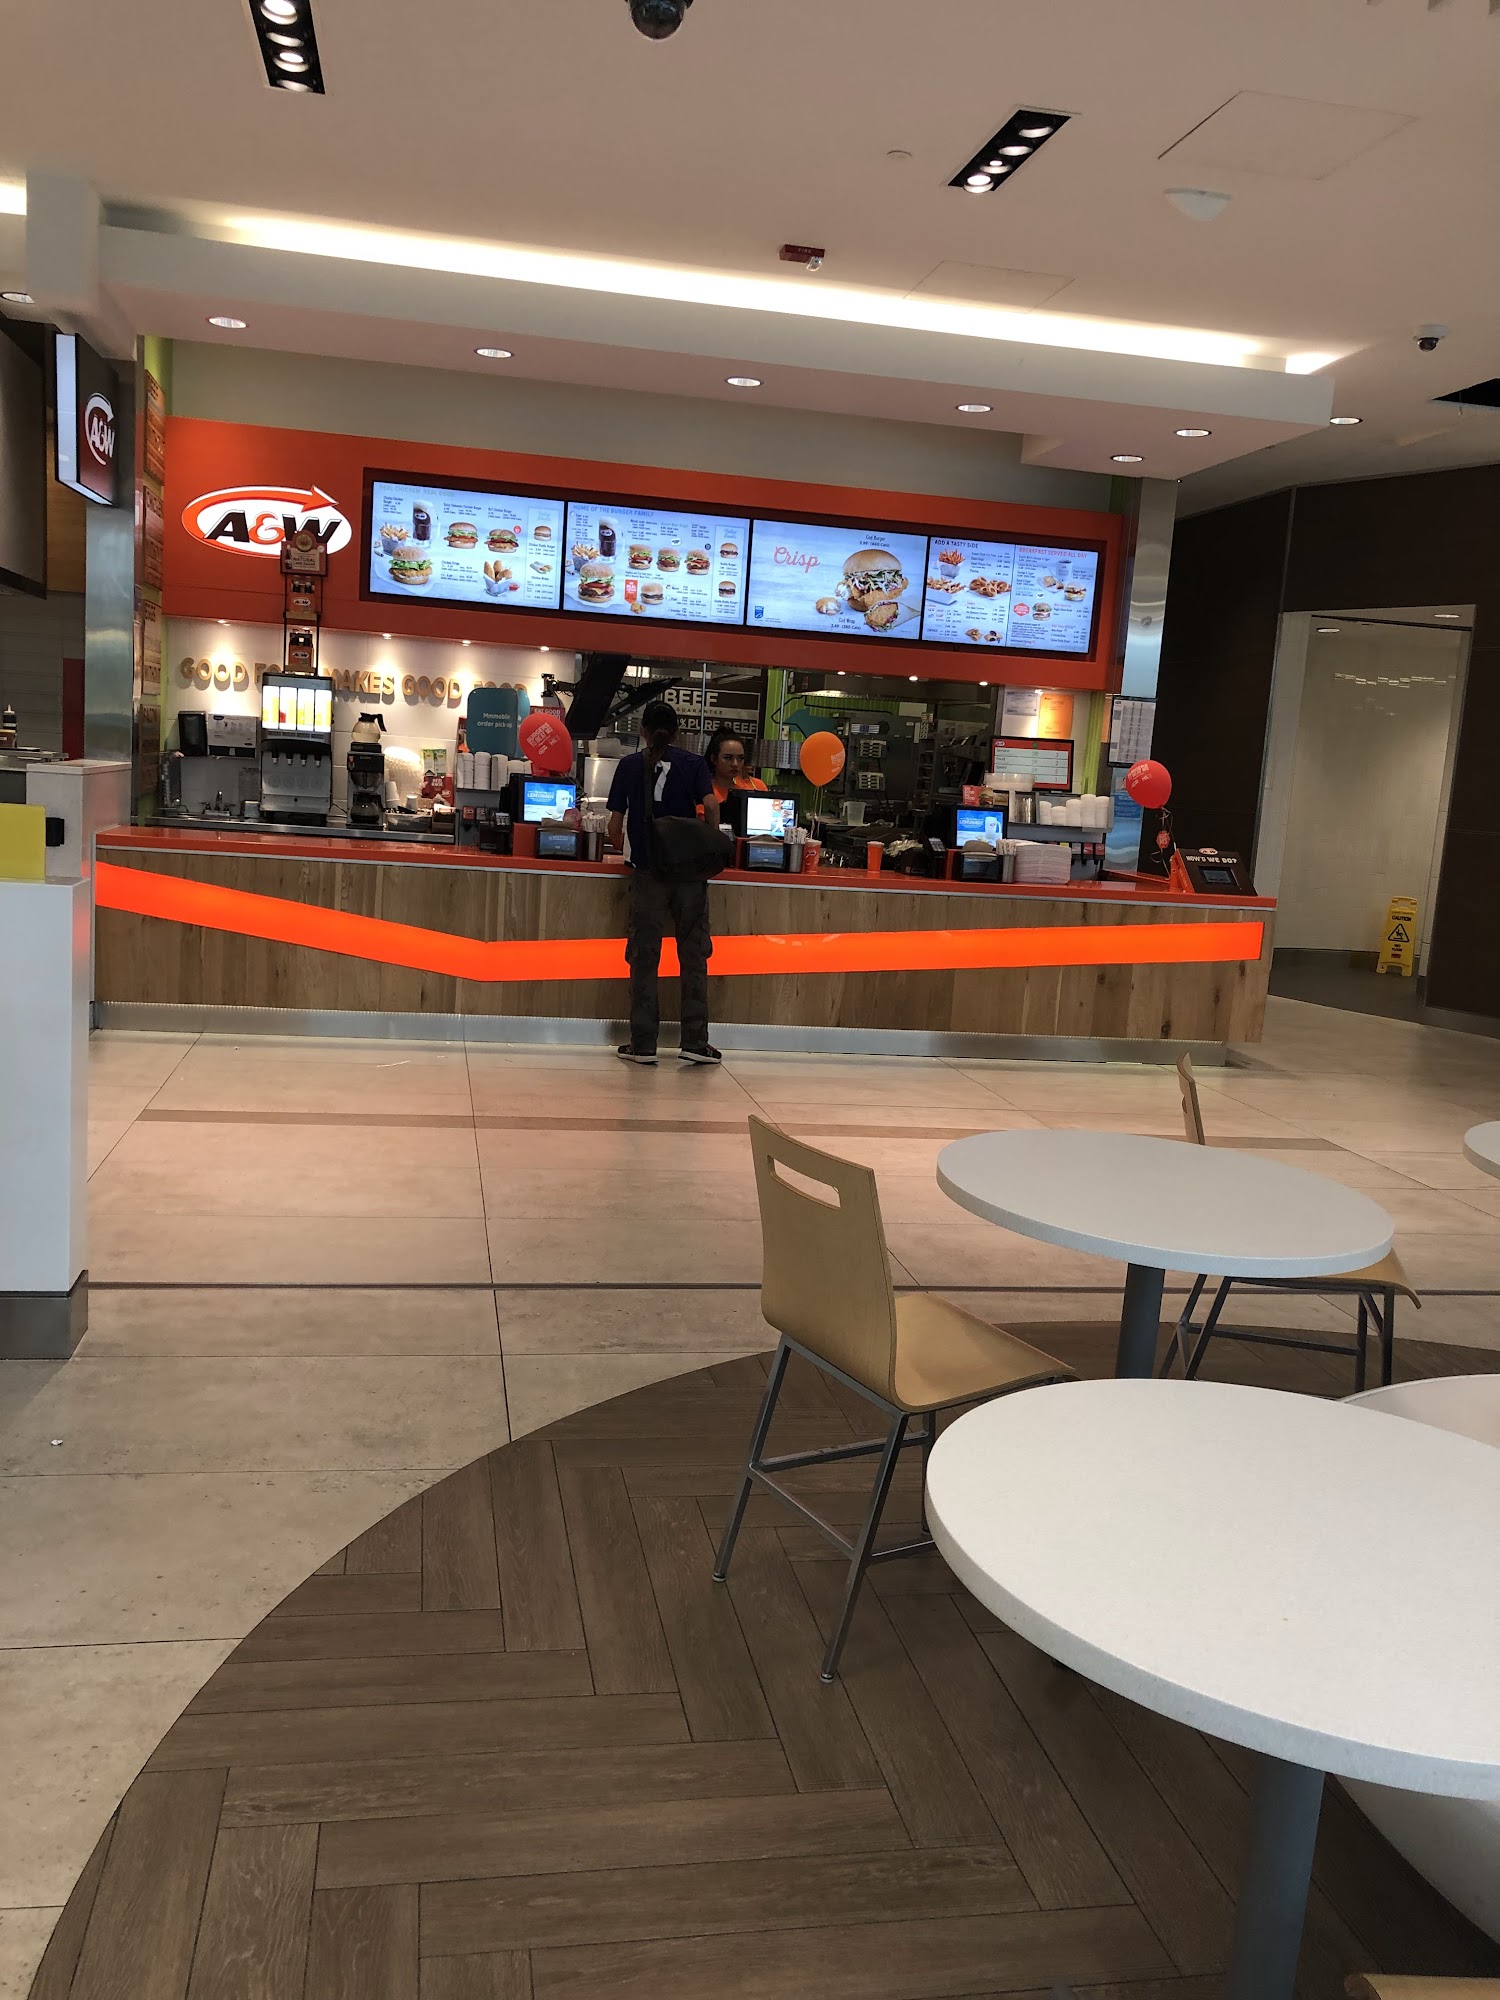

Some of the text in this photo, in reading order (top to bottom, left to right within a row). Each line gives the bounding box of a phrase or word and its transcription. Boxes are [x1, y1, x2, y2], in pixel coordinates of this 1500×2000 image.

[90, 413, 115, 458] A&W
[203, 509, 343, 545] A&W
[773, 546, 821, 573] Crisp
[1019, 547, 1048, 555] BREAKFAST
[1048, 549, 1067, 557] SERVED
[180, 657, 247, 683] GOOD
[323, 668, 395, 695] MAKES
[402, 674, 463, 700] GOOD
[664, 688, 719, 707] BEEF
[483, 712, 511, 720] Mmmobile
[676, 707, 723, 715] GUARANTEE
[688, 718, 720, 731] PURE
[653, 760, 672, 802] 7
